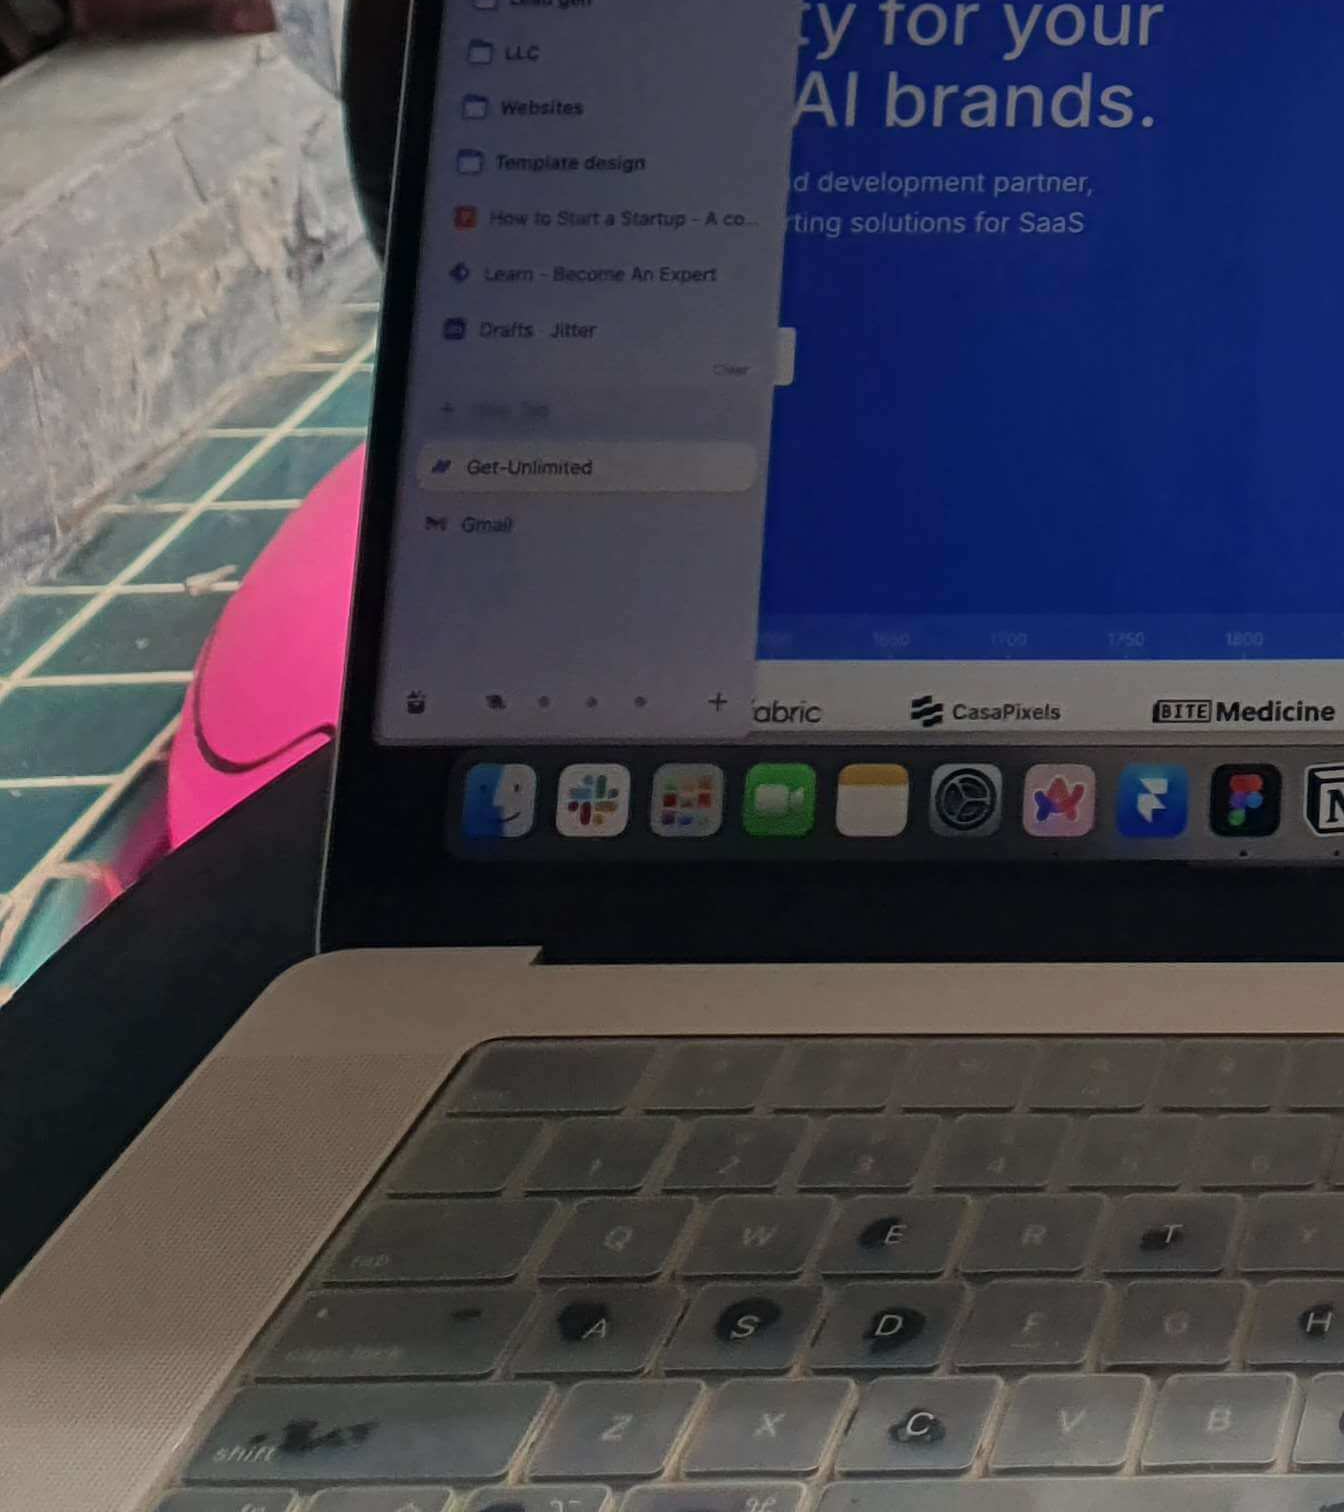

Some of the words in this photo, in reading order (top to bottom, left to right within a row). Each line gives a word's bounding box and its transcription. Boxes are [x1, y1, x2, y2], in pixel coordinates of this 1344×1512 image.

[1002, 2, 1165, 61] your
[505, 45, 540, 60] LLC
[501, 100, 584, 115] Websites
[792, 70, 859, 128] AI
[884, 70, 1156, 129] brands.
[496, 155, 579, 173] Template
[584, 155, 646, 173] design
[818, 171, 986, 198] development
[993, 174, 1097, 201] partner,
[489, 211, 529, 225] How
[535, 211, 551, 225] to
[557, 210, 599, 225] Start
[621, 210, 685, 229] Startup
[850, 211, 966, 235] solutions
[975, 211, 1011, 234] for
[1019, 211, 1086, 235] SaaS
[484, 267, 533, 281] Learn
[553, 267, 625, 281] Become
[631, 267, 654, 281] An
[659, 267, 718, 284] Expert
[480, 323, 535, 338] Drafts
[549, 323, 598, 338] Jitter
[466, 459, 593, 476] Get-Unlimited
[461, 516, 514, 533] Gmail
[1224, 632, 1265, 647] 1800
[952, 702, 1062, 721] CasaPixels
[1160, 703, 1209, 721] BITE
[1216, 701, 1336, 723] Medicine
[604, 1224, 634, 1252] Q
[740, 1225, 779, 1247] W
[883, 1224, 909, 1245] E
[1021, 1223, 1048, 1248] R
[1165, 1222, 1184, 1243] T
[582, 1317, 608, 1340] A
[730, 1314, 760, 1339] S
[874, 1314, 903, 1336] D
[1021, 1312, 1046, 1336] F
[1305, 1311, 1334, 1332] H
[600, 1415, 633, 1443] Z
[752, 1413, 786, 1439] X
[906, 1411, 936, 1436] C
[1059, 1410, 1086, 1434] V
[1207, 1409, 1233, 1432] B
[212, 1444, 277, 1463] shift
